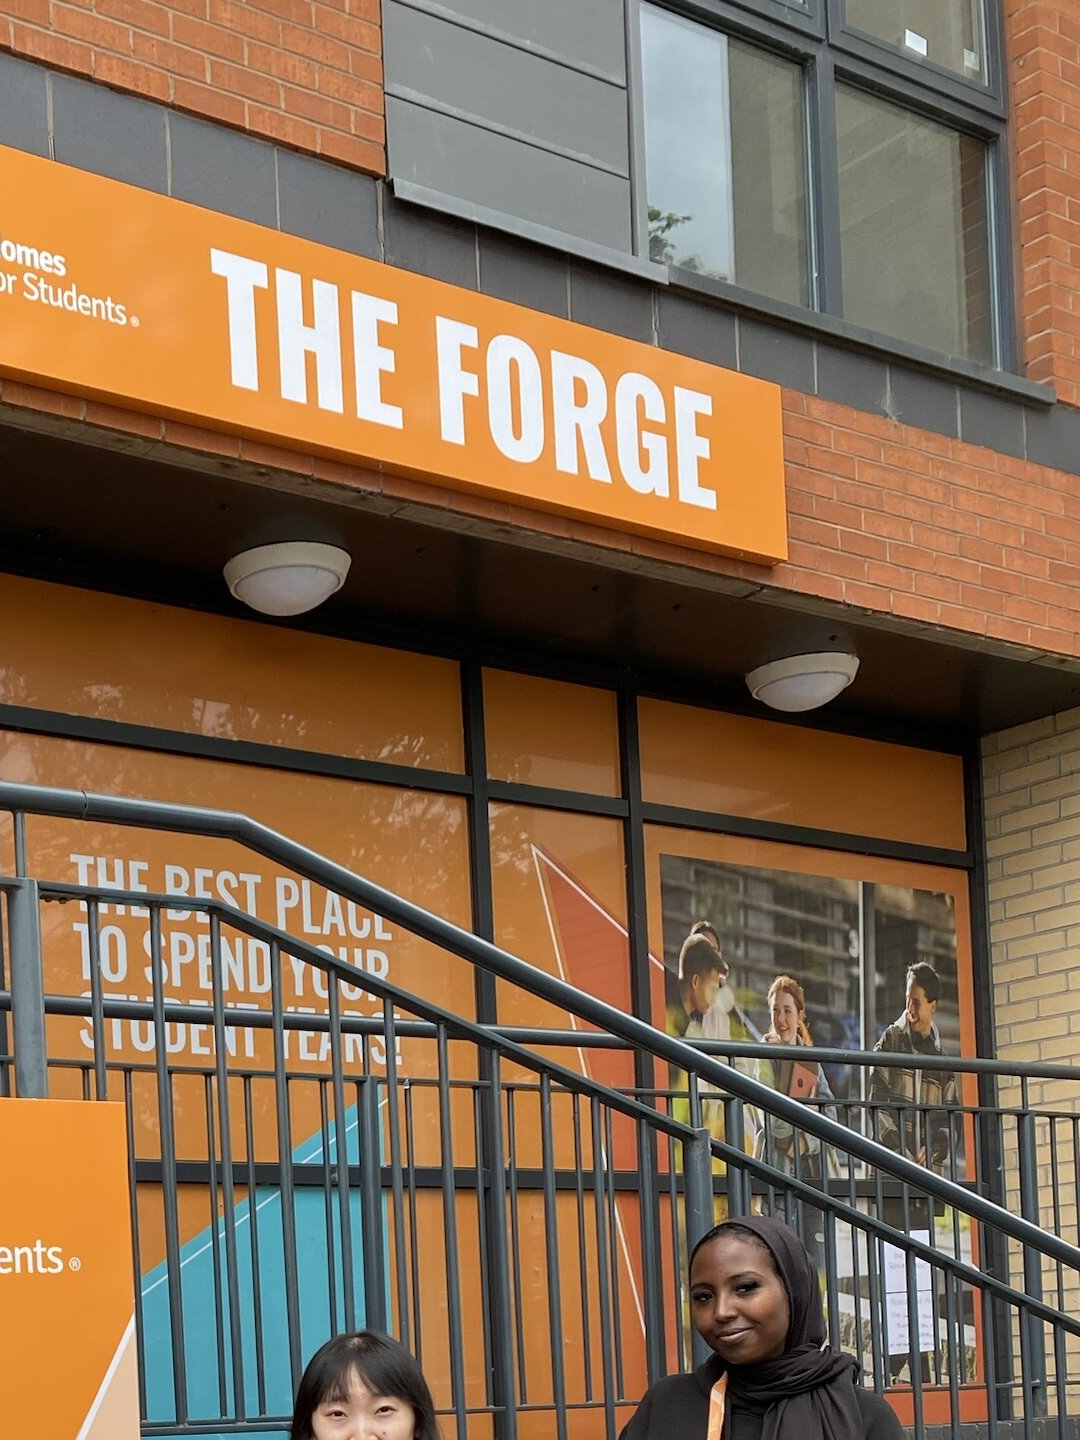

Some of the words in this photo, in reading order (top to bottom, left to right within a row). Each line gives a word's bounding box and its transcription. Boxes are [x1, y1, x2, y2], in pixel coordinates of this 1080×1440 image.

[210, 248, 404, 430] THE
[436, 315, 718, 511] FORGE
[70, 854, 149, 917] THE
[164, 864, 262, 924] BEST
[73, 923, 128, 983] TO
[143, 929, 271, 993] SPEND
